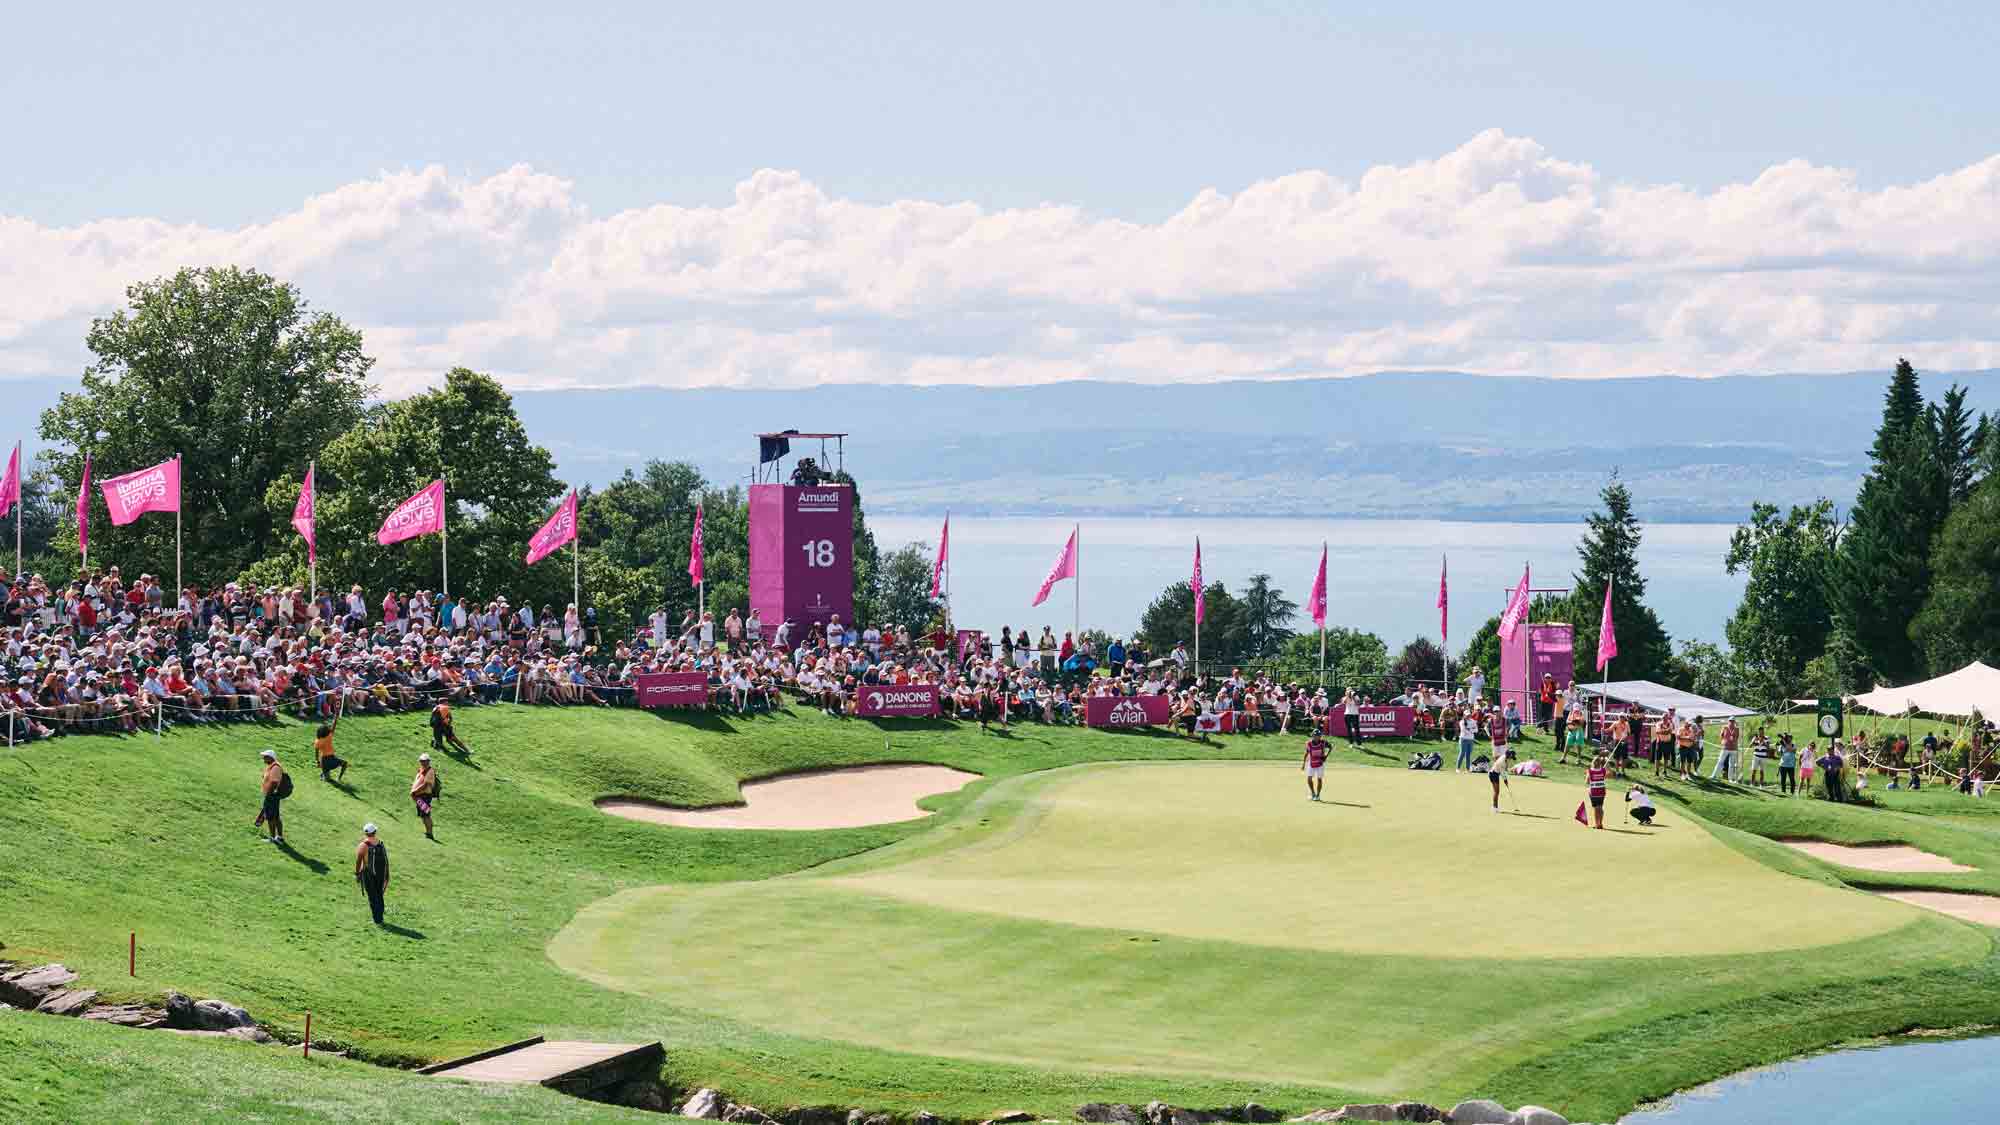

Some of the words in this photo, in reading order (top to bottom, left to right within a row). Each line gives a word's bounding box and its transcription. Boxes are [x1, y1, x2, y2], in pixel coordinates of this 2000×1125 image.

[799, 492, 840, 504] Amundi
[803, 540, 836, 567] 18
[647, 684, 703, 694] PORSCHE
[1110, 710, 1148, 724] evian
[1359, 711, 1395, 722] mundi
